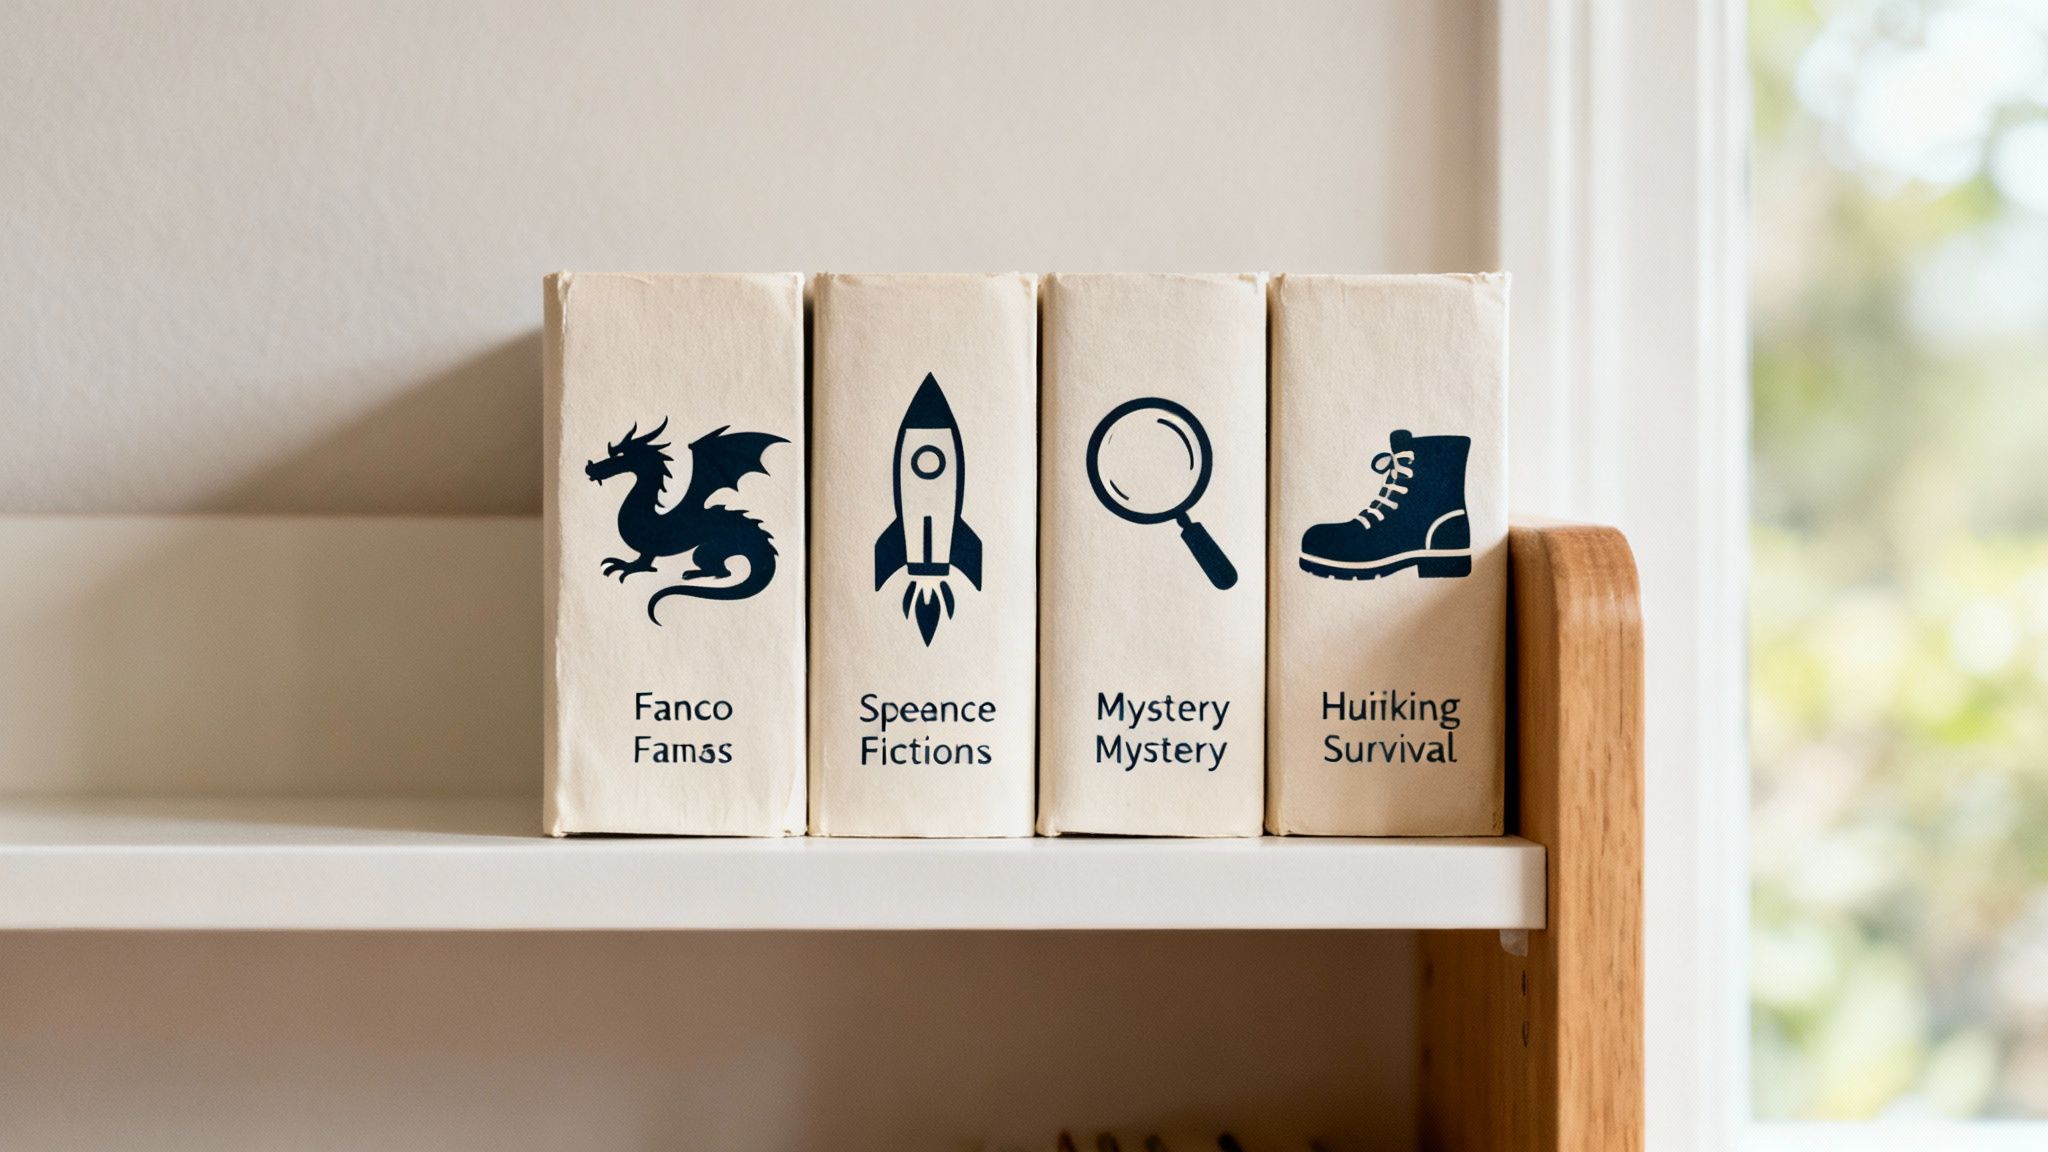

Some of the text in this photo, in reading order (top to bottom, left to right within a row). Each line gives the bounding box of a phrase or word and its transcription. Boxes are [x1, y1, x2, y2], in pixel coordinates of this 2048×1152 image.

[635, 691, 733, 722] Fanco
[1097, 692, 1230, 731] Mystery
[861, 734, 992, 766] Fictions
[1096, 734, 1228, 772] Mystery
[1324, 730, 1459, 765] Survival
